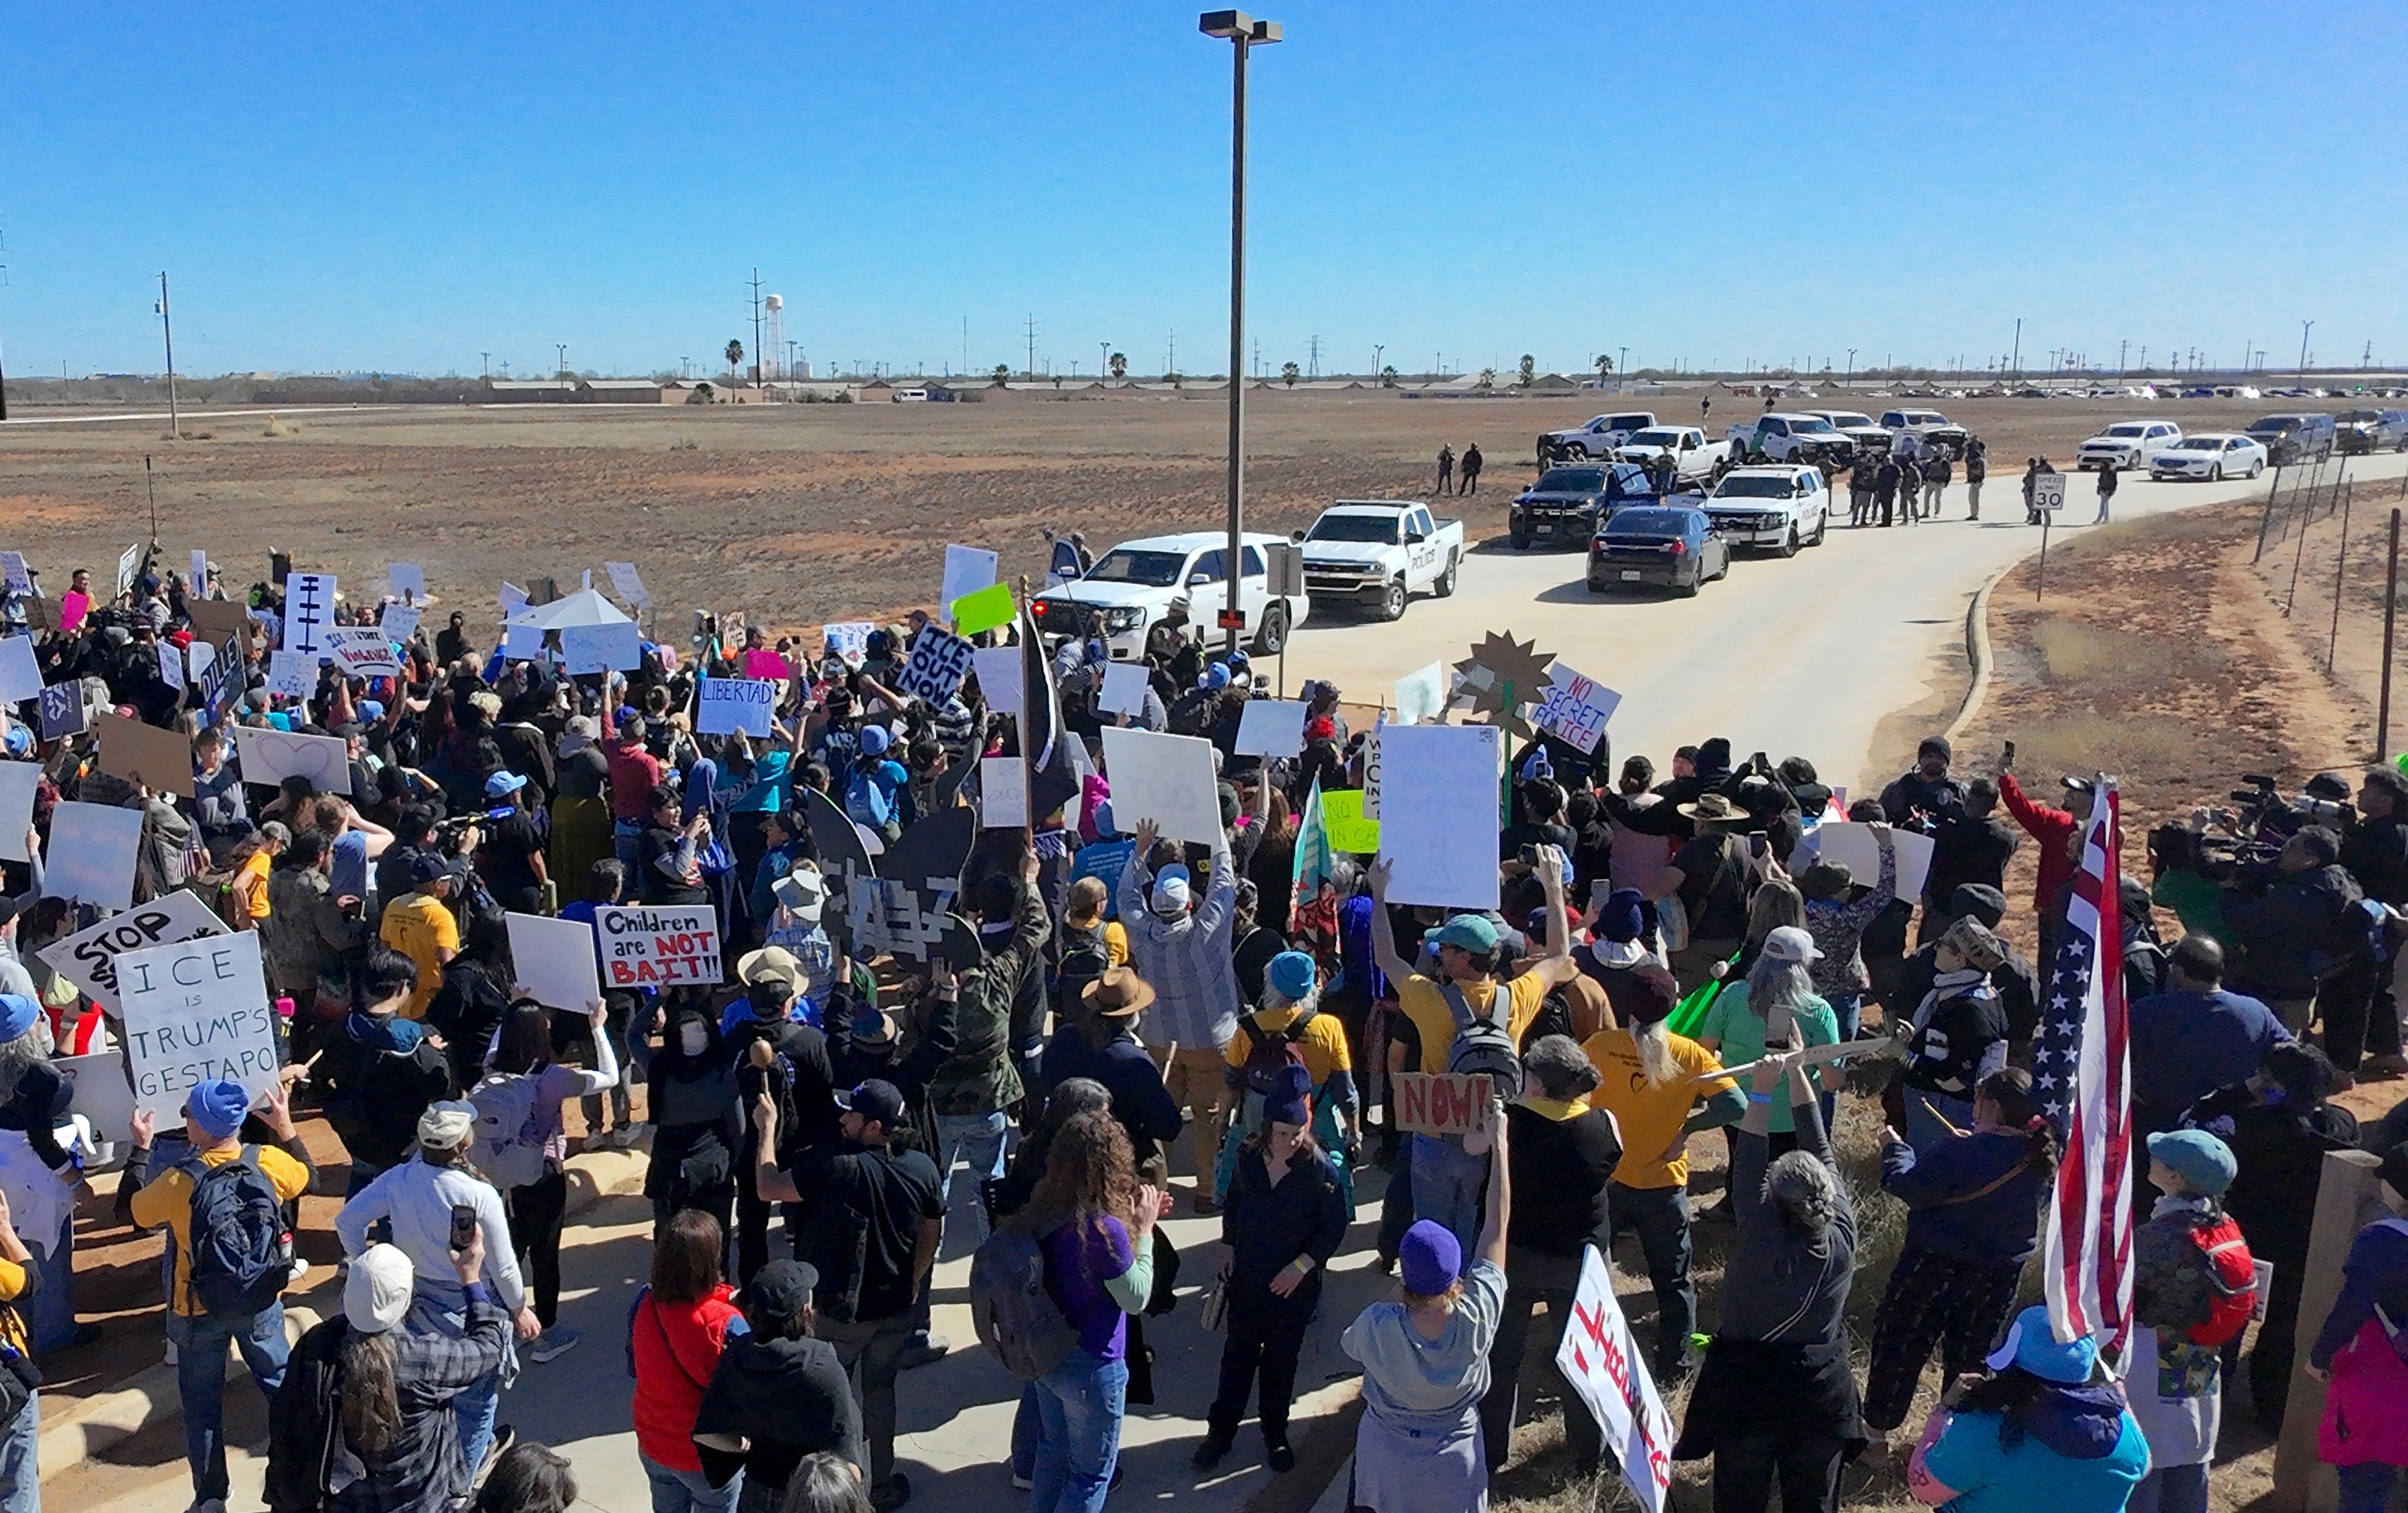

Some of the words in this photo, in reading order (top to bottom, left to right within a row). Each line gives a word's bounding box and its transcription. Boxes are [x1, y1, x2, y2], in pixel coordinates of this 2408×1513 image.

[2036, 492, 2061, 506] 30
[1411, 549, 1435, 571] POLICE
[920, 627, 975, 670] ICE
[913, 651, 961, 689] OUT
[702, 680, 772, 704] LIBERTAD
[901, 668, 956, 708] NOW
[1567, 676, 1593, 702] NO
[1545, 687, 1606, 729] SECRET
[1326, 800, 1351, 820] NO
[1332, 829, 1347, 844] IN
[604, 910, 699, 934] Children
[74, 912, 171, 971] STOP
[614, 940, 646, 956] are
[654, 931, 714, 957] NOT
[134, 949, 235, 994] ICE
[610, 955, 718, 984] BAIT!!
[185, 994, 203, 1007] IS
[131, 1008, 269, 1059] TRUMP'S
[140, 1047, 274, 1096] GESTAPO
[1404, 1077, 1489, 1132] NOW!
